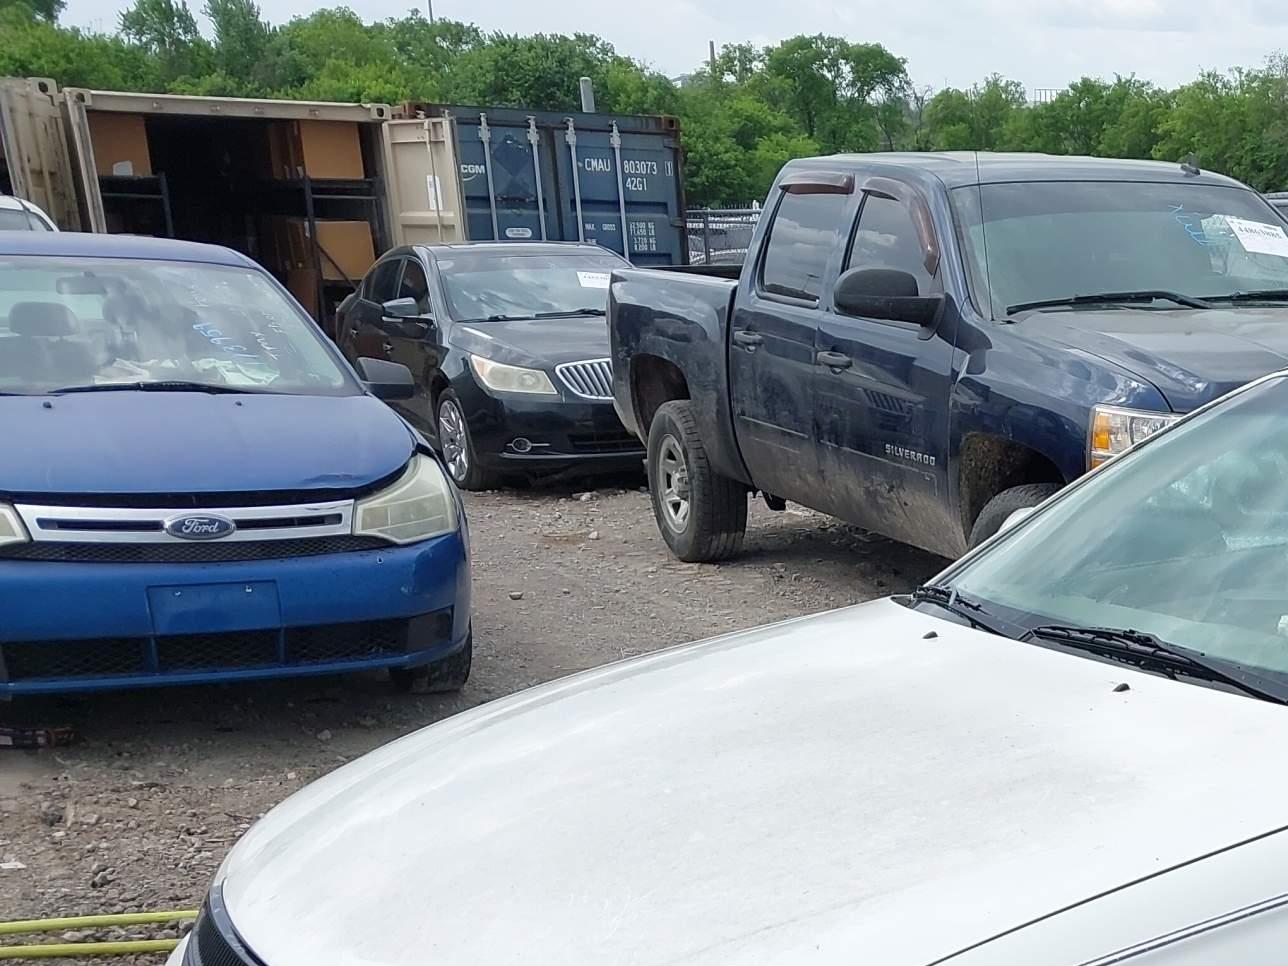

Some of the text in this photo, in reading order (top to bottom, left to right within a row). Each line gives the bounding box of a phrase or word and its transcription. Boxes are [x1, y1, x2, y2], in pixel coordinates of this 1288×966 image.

[460, 164, 486, 174] CGM
[584, 158, 611, 172] CMAU
[623, 160, 657, 175] 803073
[625, 177, 647, 191] 42G1
[885, 443, 936, 466] SILVERADO
[182, 518, 219, 533] Ford
